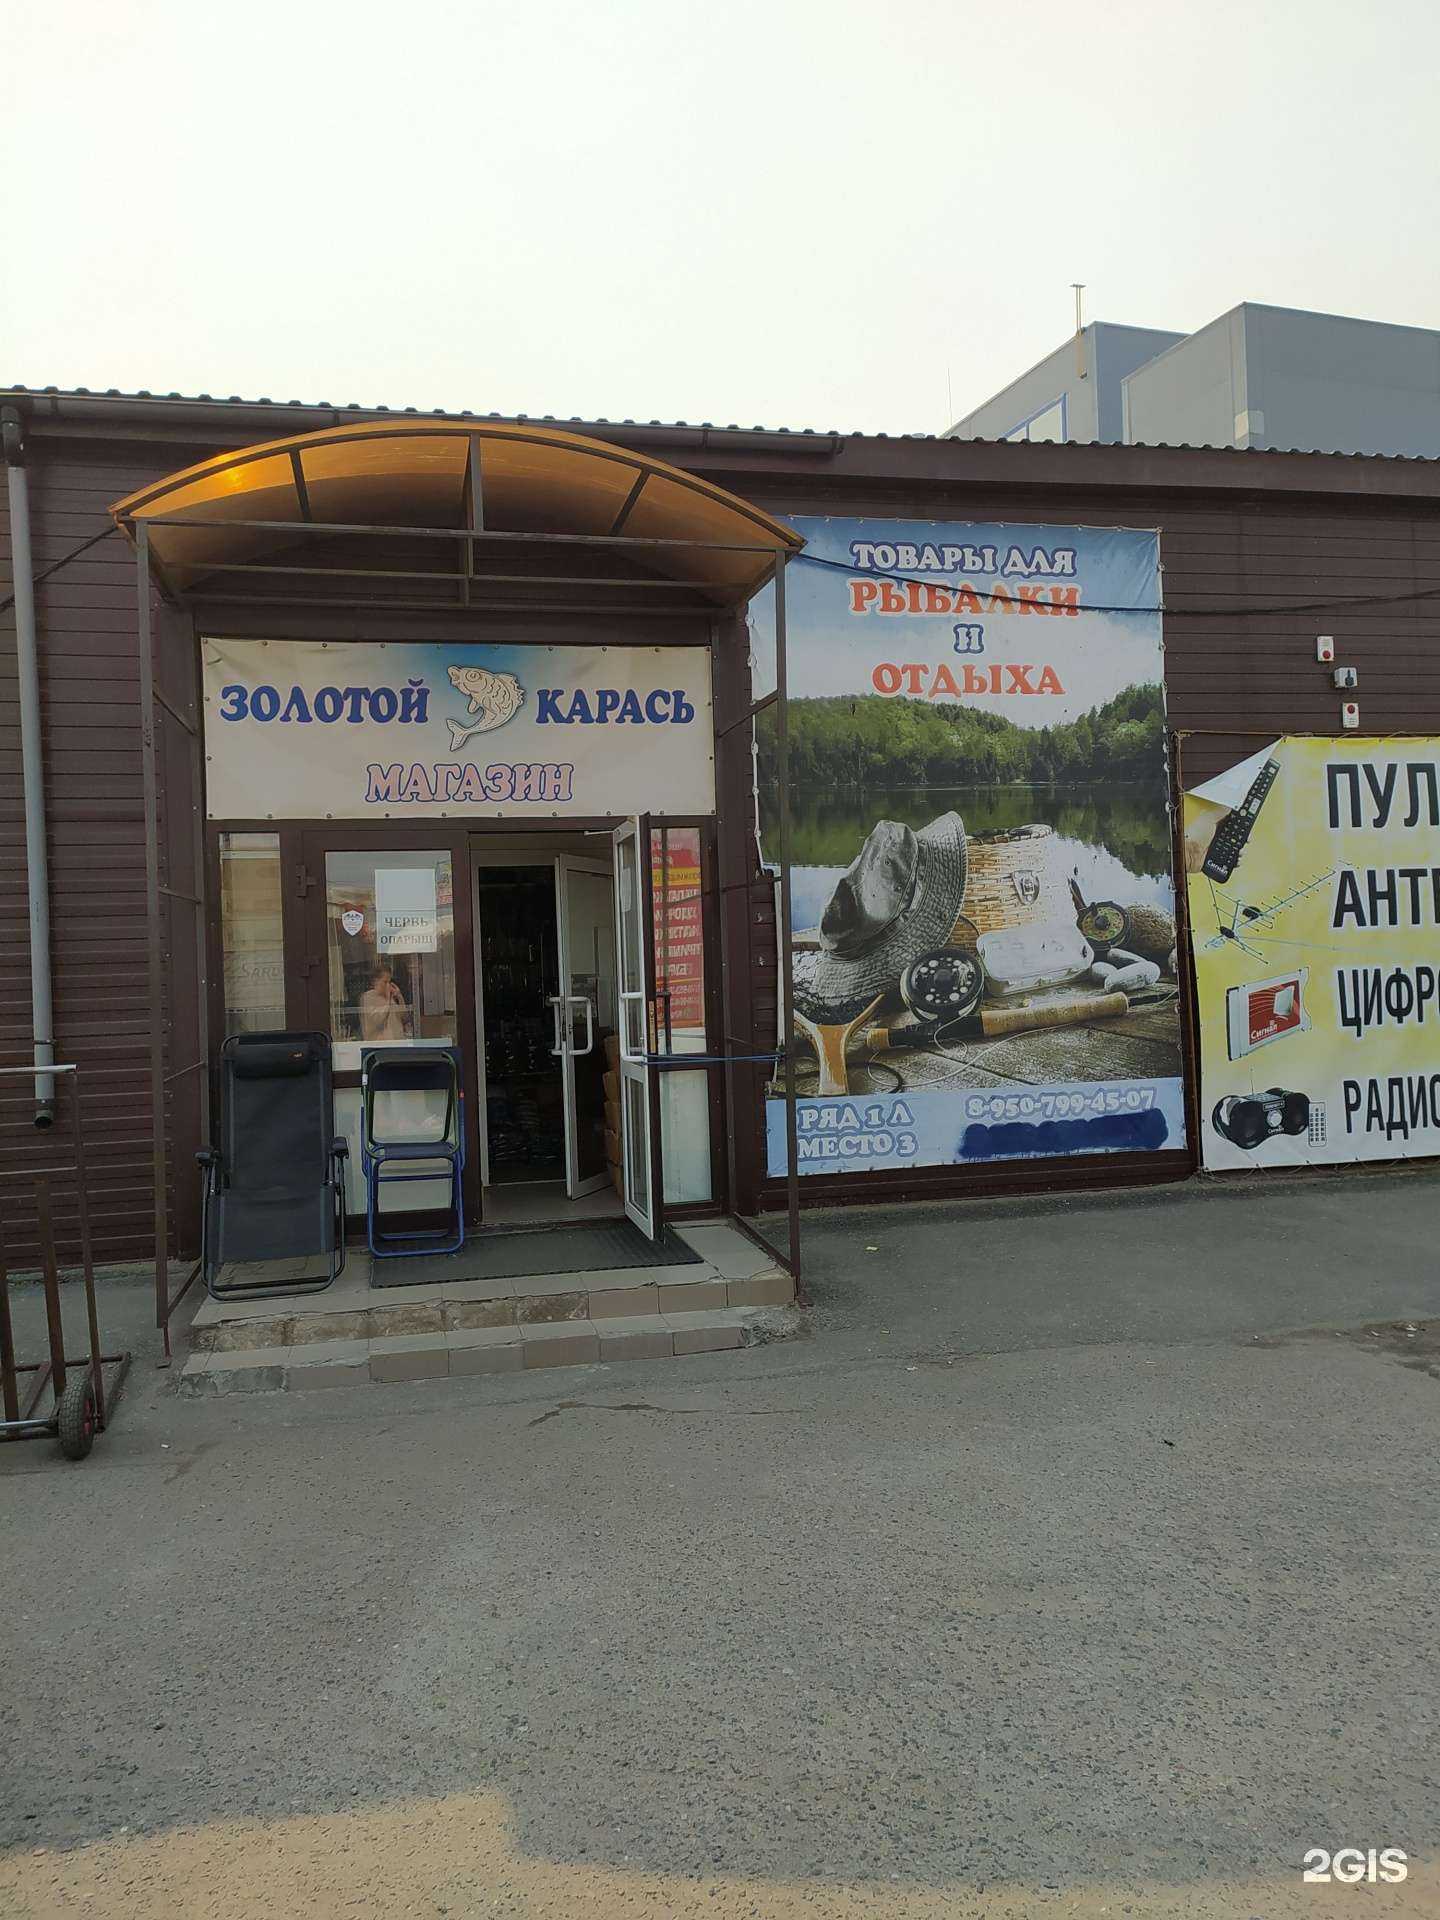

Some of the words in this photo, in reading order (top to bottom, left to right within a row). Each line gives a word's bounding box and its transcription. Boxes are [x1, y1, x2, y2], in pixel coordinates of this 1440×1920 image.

[850, 541, 998, 573] ТОВАРЫ
[1001, 546, 1077, 577] ДЛЯ
[849, 581, 1081, 617] РЫБАЛКИ
[954, 624, 984, 653] И
[871, 662, 1066, 697] ОТДЫХА
[220, 678, 430, 723] ЗОЛОТОЙ
[536, 689, 695, 724] КАРАСЬ
[365, 763, 574, 802] МАГАЗИН
[384, 916, 429, 928] ЧЕРВЬ
[1337, 966, 1440, 1037] ЦИФР
[799, 1104, 862, 1131] РЯД
[865, 1106, 884, 1127] 1
[967, 1089, 1156, 1118] 8-950-799-45-07
[798, 1131, 893, 1160] МЕСТО
[898, 1132, 918, 1156] 3
